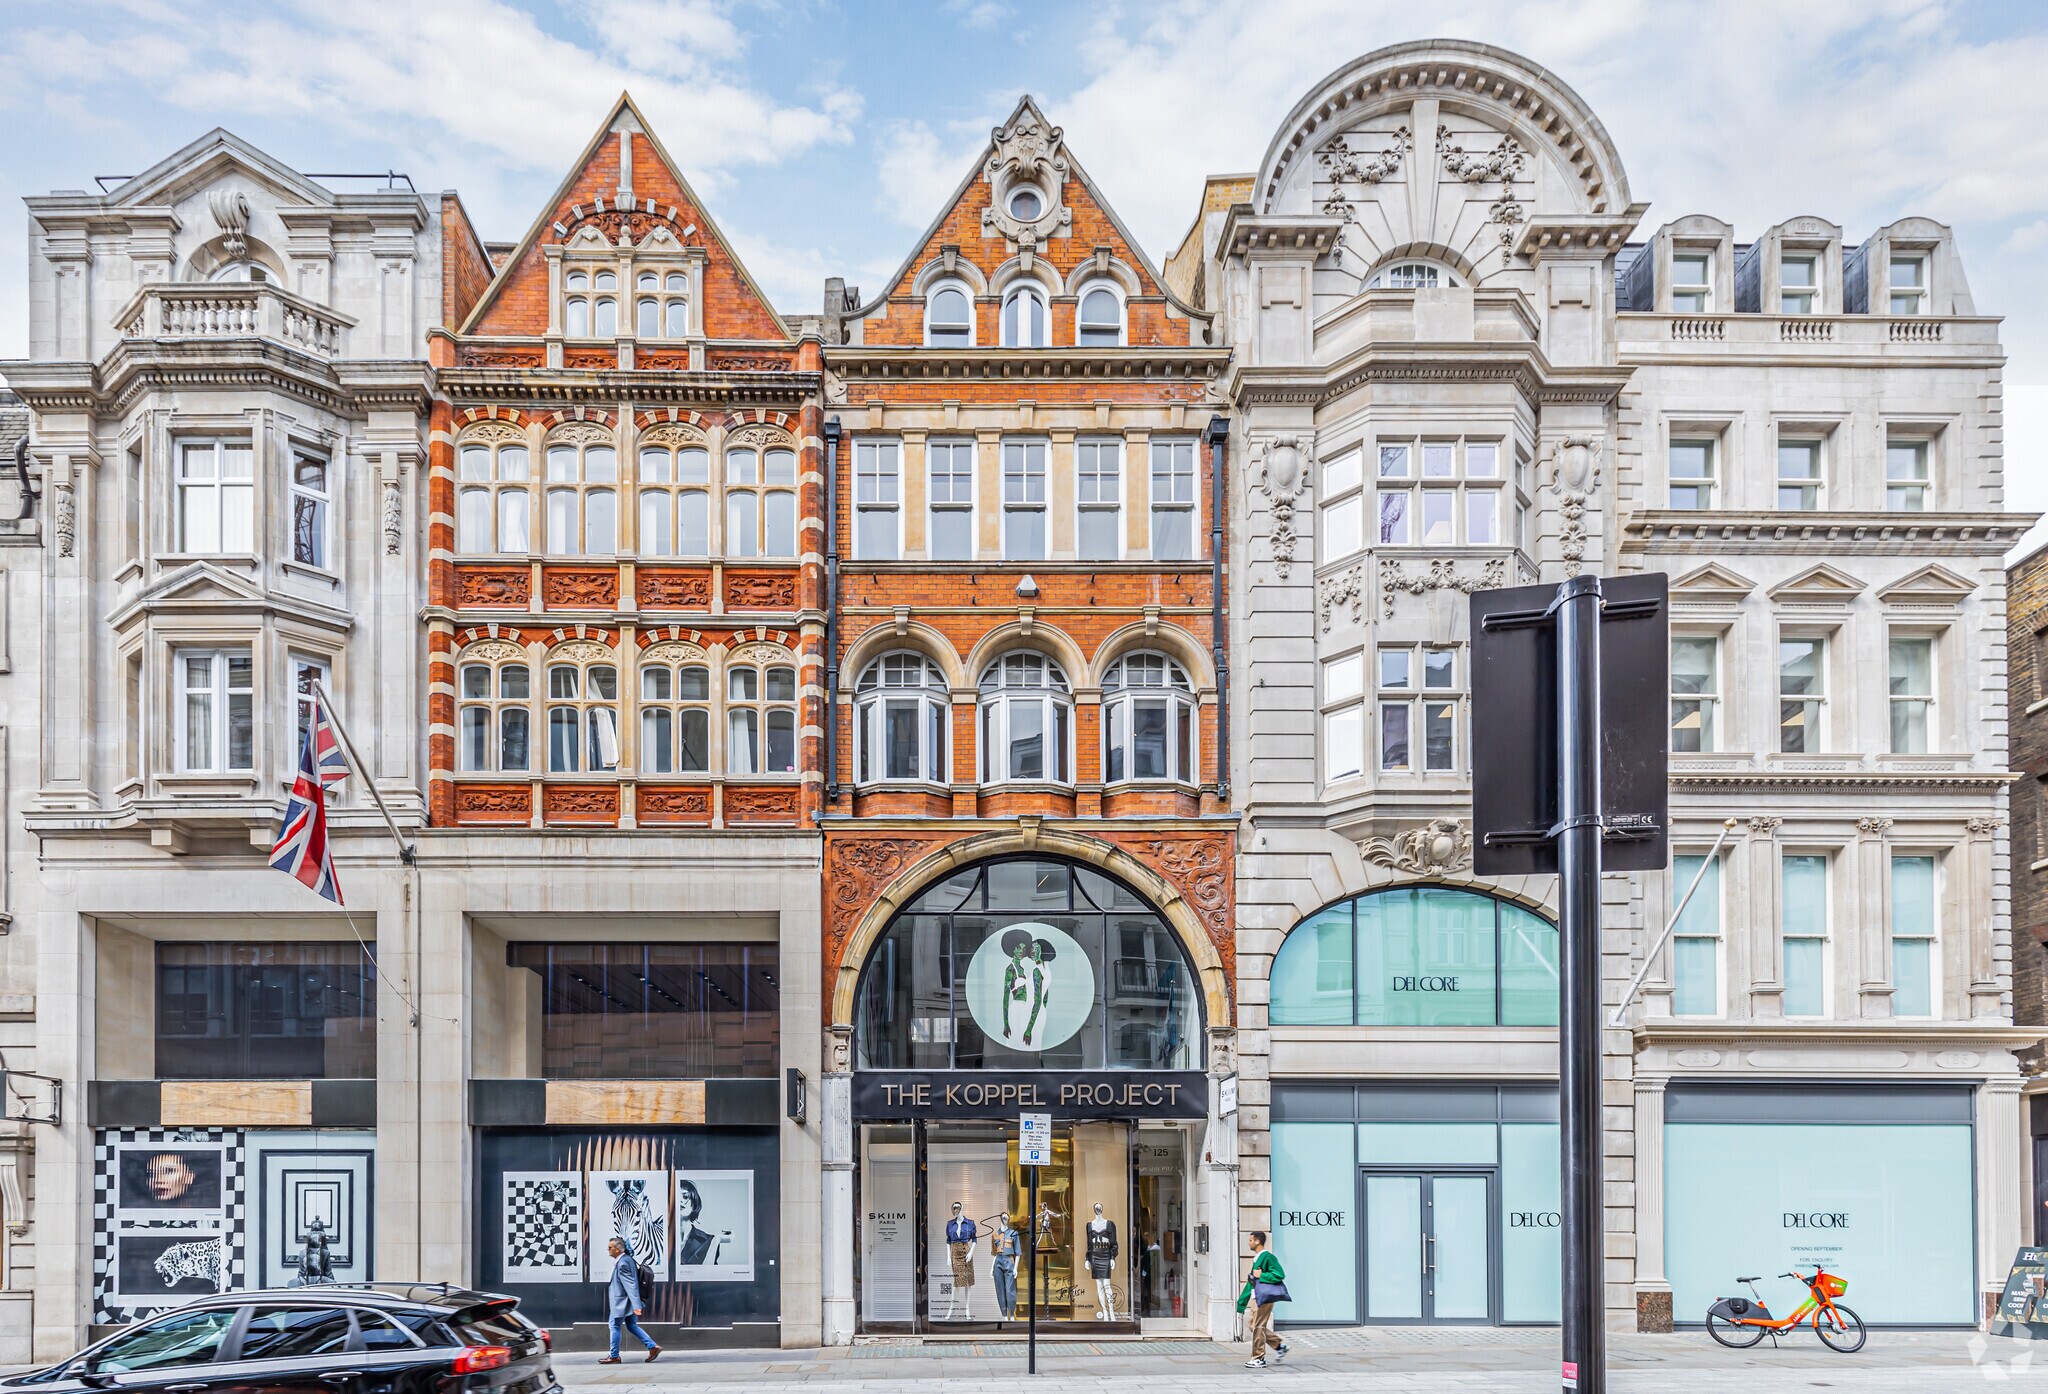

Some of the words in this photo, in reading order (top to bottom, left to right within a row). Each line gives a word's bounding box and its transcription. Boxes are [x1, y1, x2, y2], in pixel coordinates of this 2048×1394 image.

[1009, 140, 1046, 157] 1899
[880, 1084, 932, 1106] THE
[946, 1083, 1047, 1106] KOPPEL
[1060, 1083, 1182, 1106] PROJECT
[1153, 1148, 1168, 1157] 125
[868, 1212, 906, 1220] SKIIM
